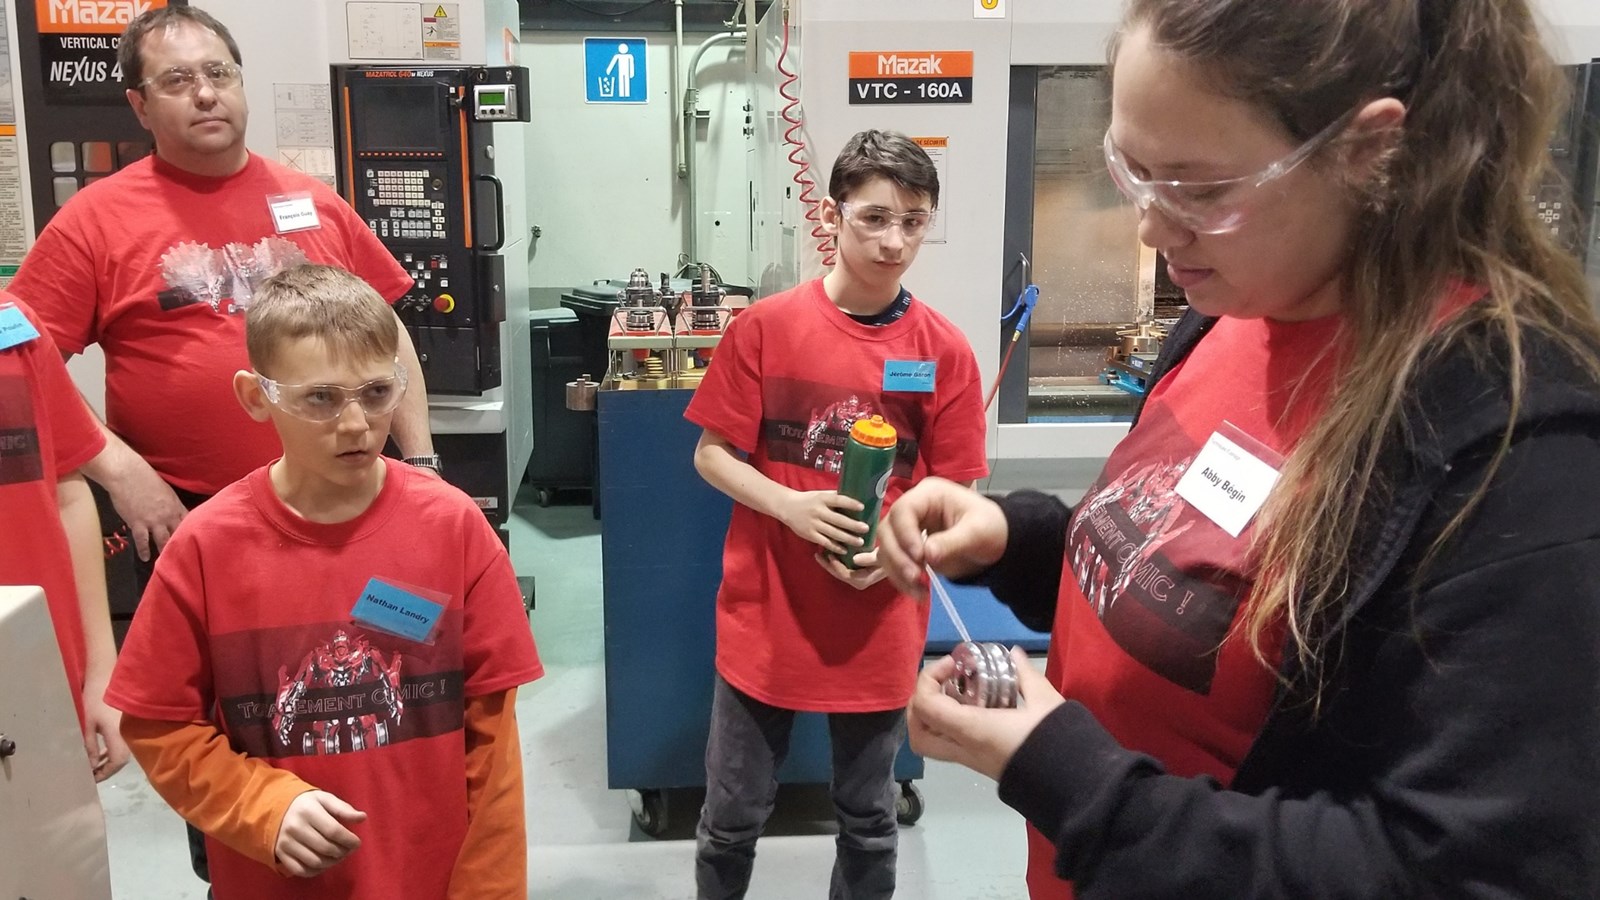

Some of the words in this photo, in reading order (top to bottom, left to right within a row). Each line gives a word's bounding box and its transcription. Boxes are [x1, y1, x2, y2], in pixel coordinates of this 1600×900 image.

[60, 37, 109, 49] VERTICAL
[50, 56, 107, 86] NEXUS
[877, 54, 942, 75] Mazak
[857, 83, 898, 98] VTC
[918, 82, 963, 98] 160A
[1201, 467, 1222, 487] Abby
[366, 594, 398, 611] Nathan
[400, 607, 429, 624] Landry
